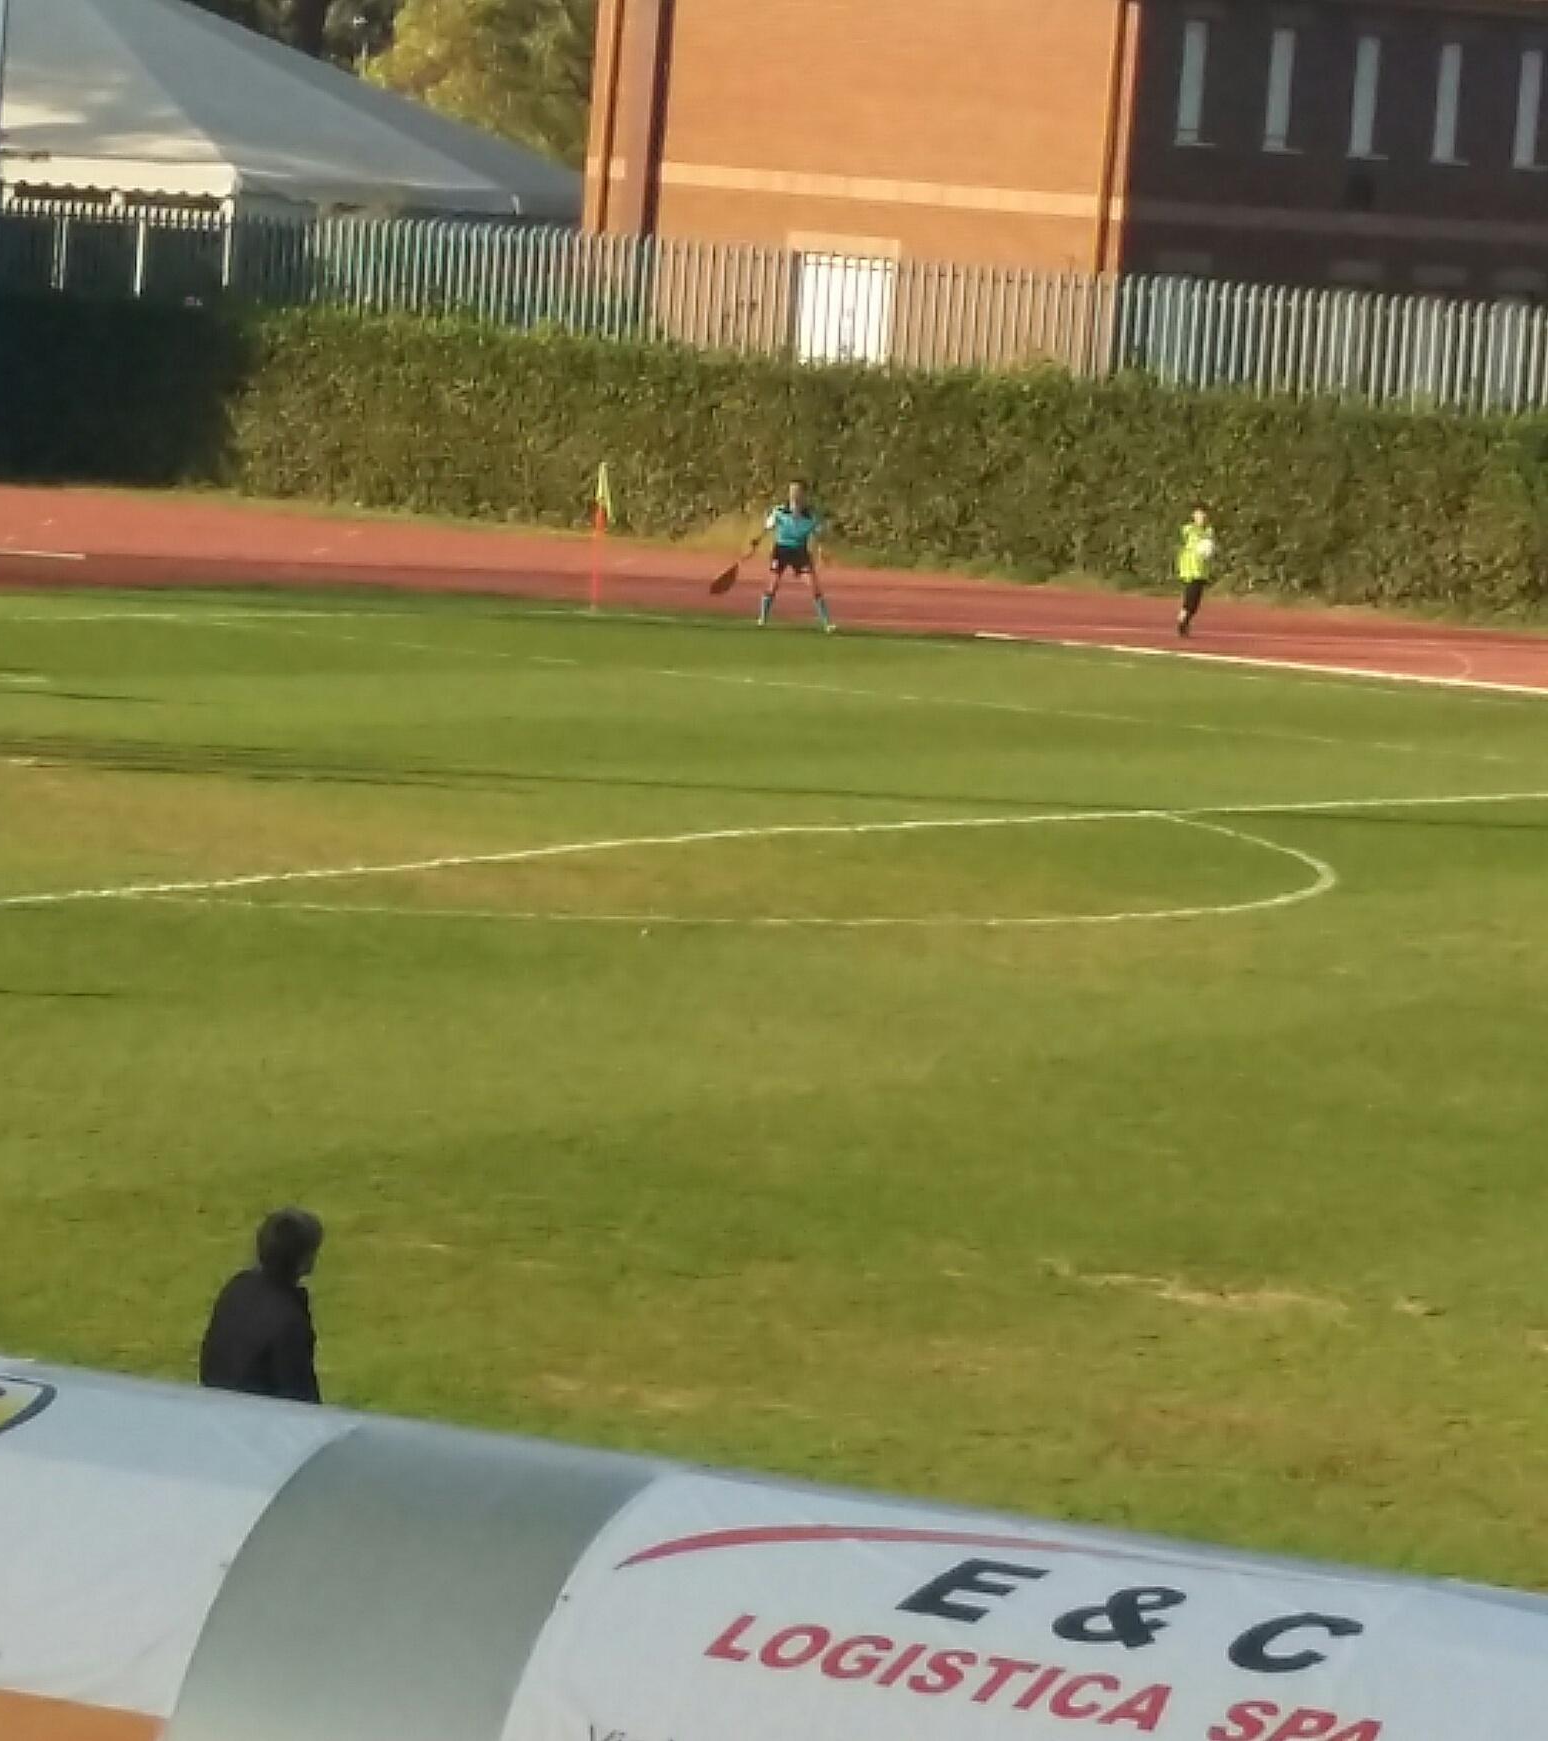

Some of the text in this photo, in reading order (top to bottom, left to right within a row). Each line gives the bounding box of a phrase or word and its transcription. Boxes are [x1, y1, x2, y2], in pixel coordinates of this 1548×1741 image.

[704, 1613, 1172, 1731] LOGISTICA
[894, 1557, 1364, 1674] E & C
